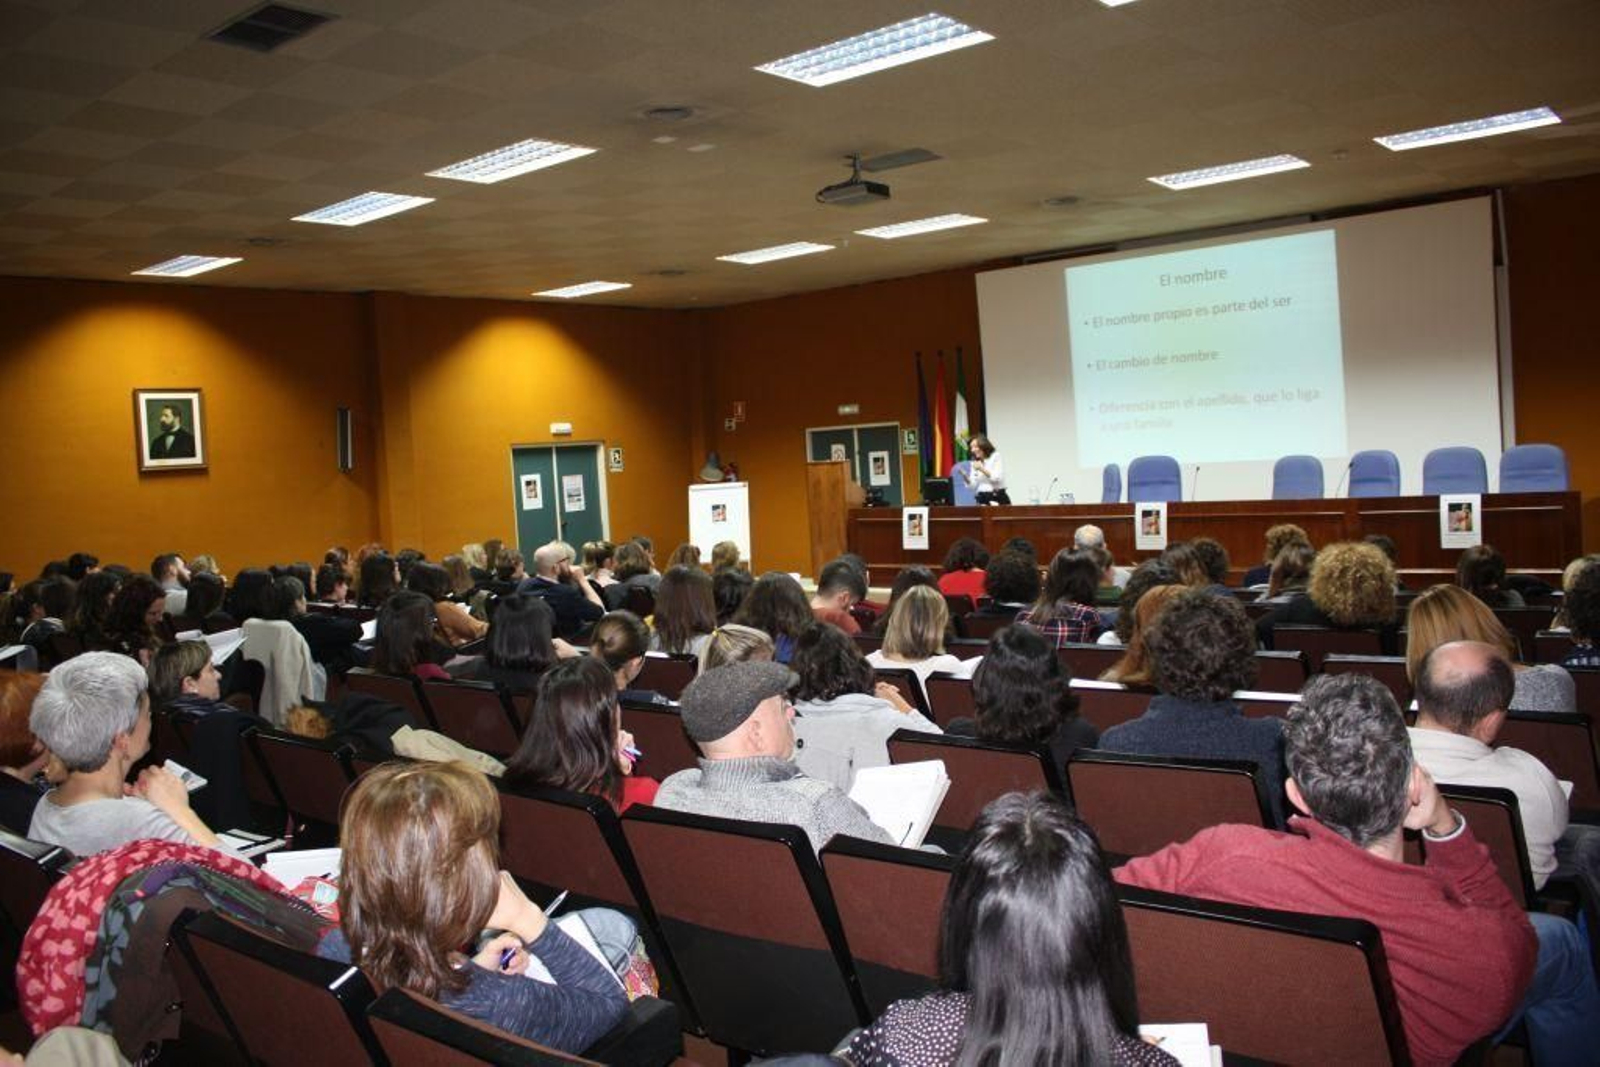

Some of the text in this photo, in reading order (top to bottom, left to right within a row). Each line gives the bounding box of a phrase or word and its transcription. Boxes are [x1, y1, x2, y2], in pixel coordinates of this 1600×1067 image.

[1159, 268, 1228, 287] El nombre
[1092, 296, 1292, 329] El nombre propio es parte del ser
[1095, 349, 1220, 371] El cambio de nombre
[1252, 392, 1278, 405] que
[1280, 389, 1294, 402] lo
[1296, 387, 1320, 403] liga
